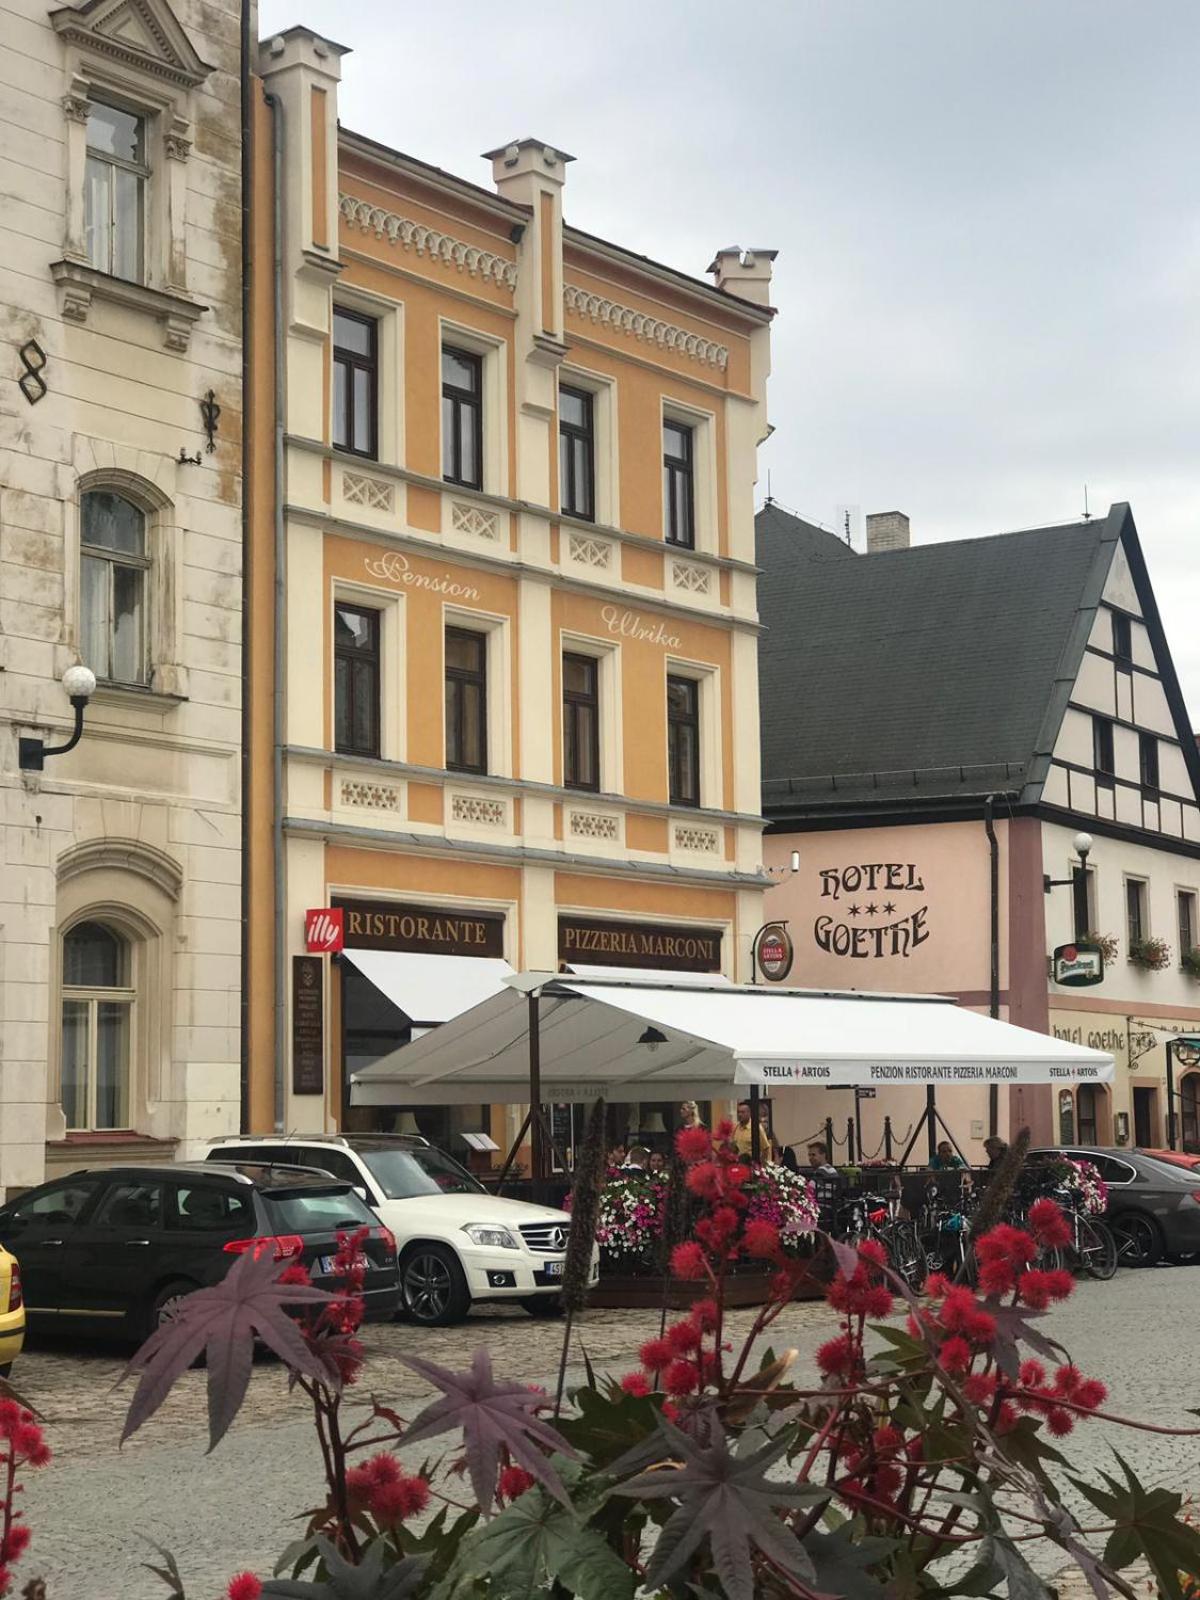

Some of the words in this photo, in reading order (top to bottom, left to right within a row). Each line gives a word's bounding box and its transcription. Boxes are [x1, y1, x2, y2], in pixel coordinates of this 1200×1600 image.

[364, 551, 480, 600] Pension
[819, 863, 925, 900] HOTEL
[308, 914, 339, 948] illy
[348, 911, 487, 944] RISTORANTE
[564, 928, 638, 953] PIZZERIA
[641, 934, 714, 960] MARCONI
[814, 905, 930, 958] GOETHE
[763, 1066, 793, 1077] STELLA
[801, 1066, 831, 1078] ARTOIS
[870, 1066, 904, 1079] PENZION
[905, 1066, 952, 1079] RISTORANTE
[953, 1066, 983, 1079] PIZZERIA
[985, 1066, 1018, 1079] MARCONI
[1049, 1067, 1071, 1077] STELLA
[1077, 1067, 1098, 1077] ARTOIS
